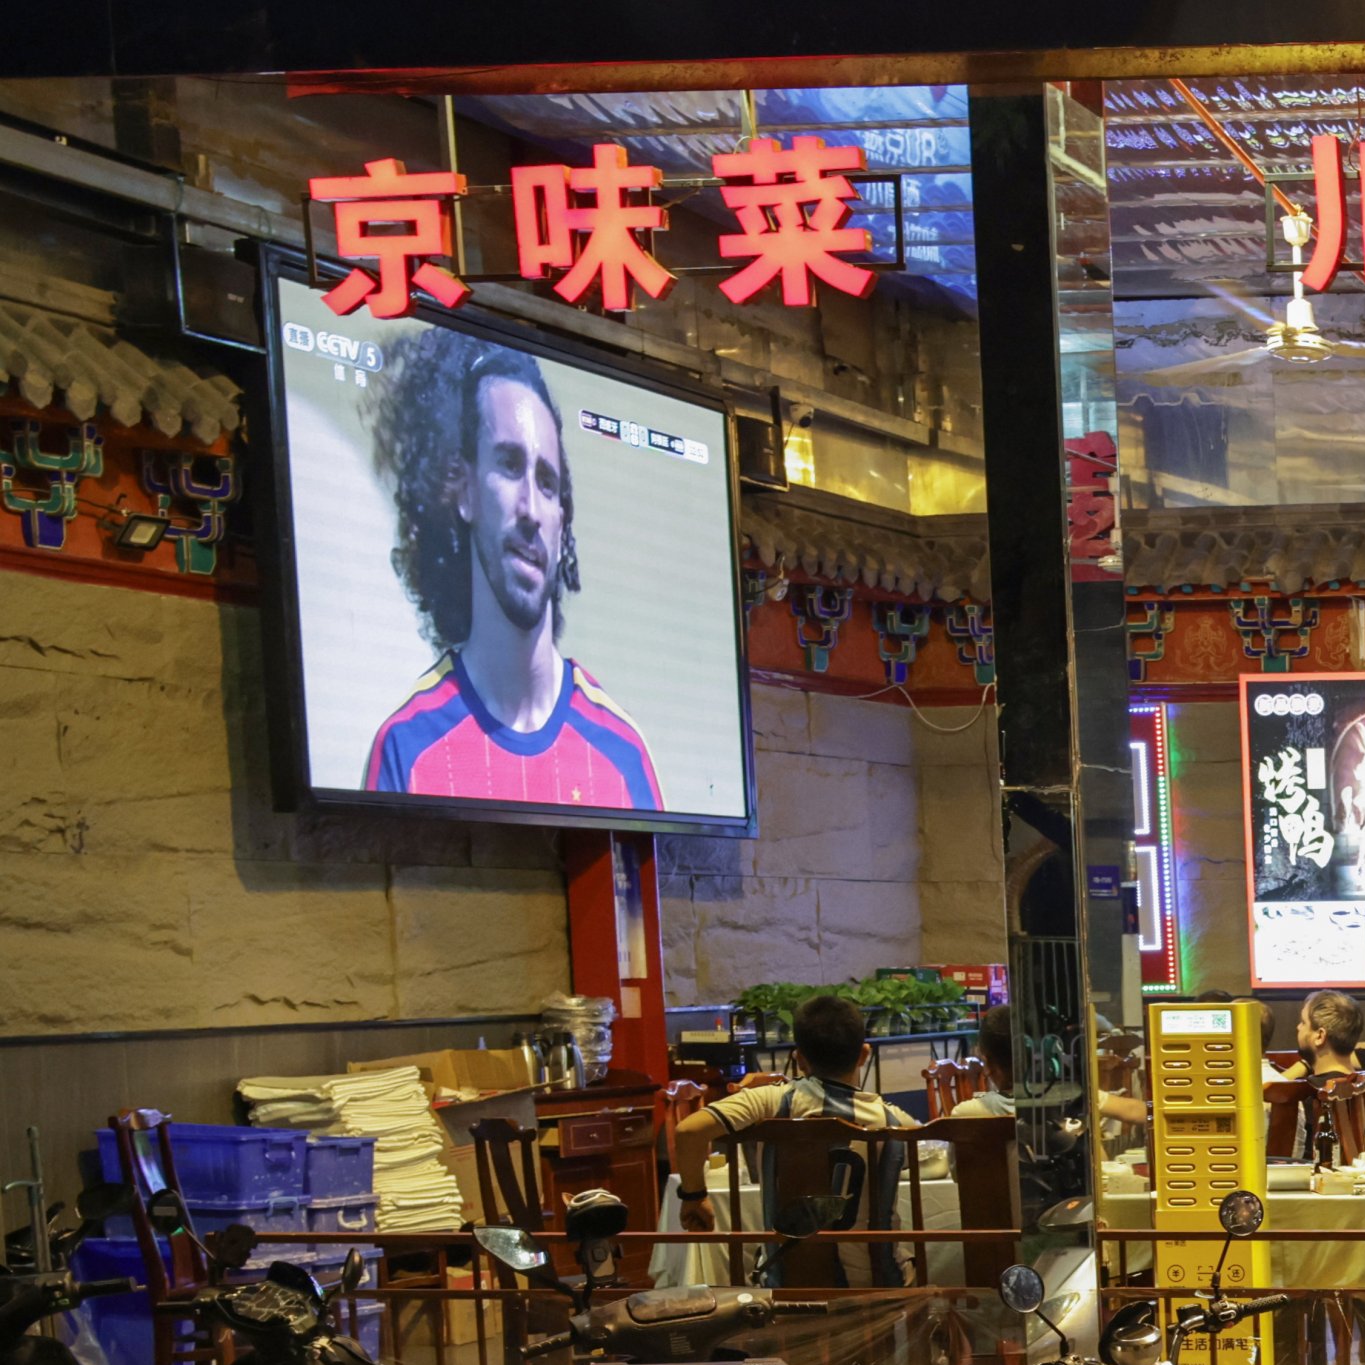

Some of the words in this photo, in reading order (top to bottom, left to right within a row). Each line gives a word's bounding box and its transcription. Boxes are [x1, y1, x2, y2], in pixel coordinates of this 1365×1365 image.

[309, 136, 878, 320] 京味菜
[316, 321, 360, 361] CCTV
[366, 346, 377, 367] 5
